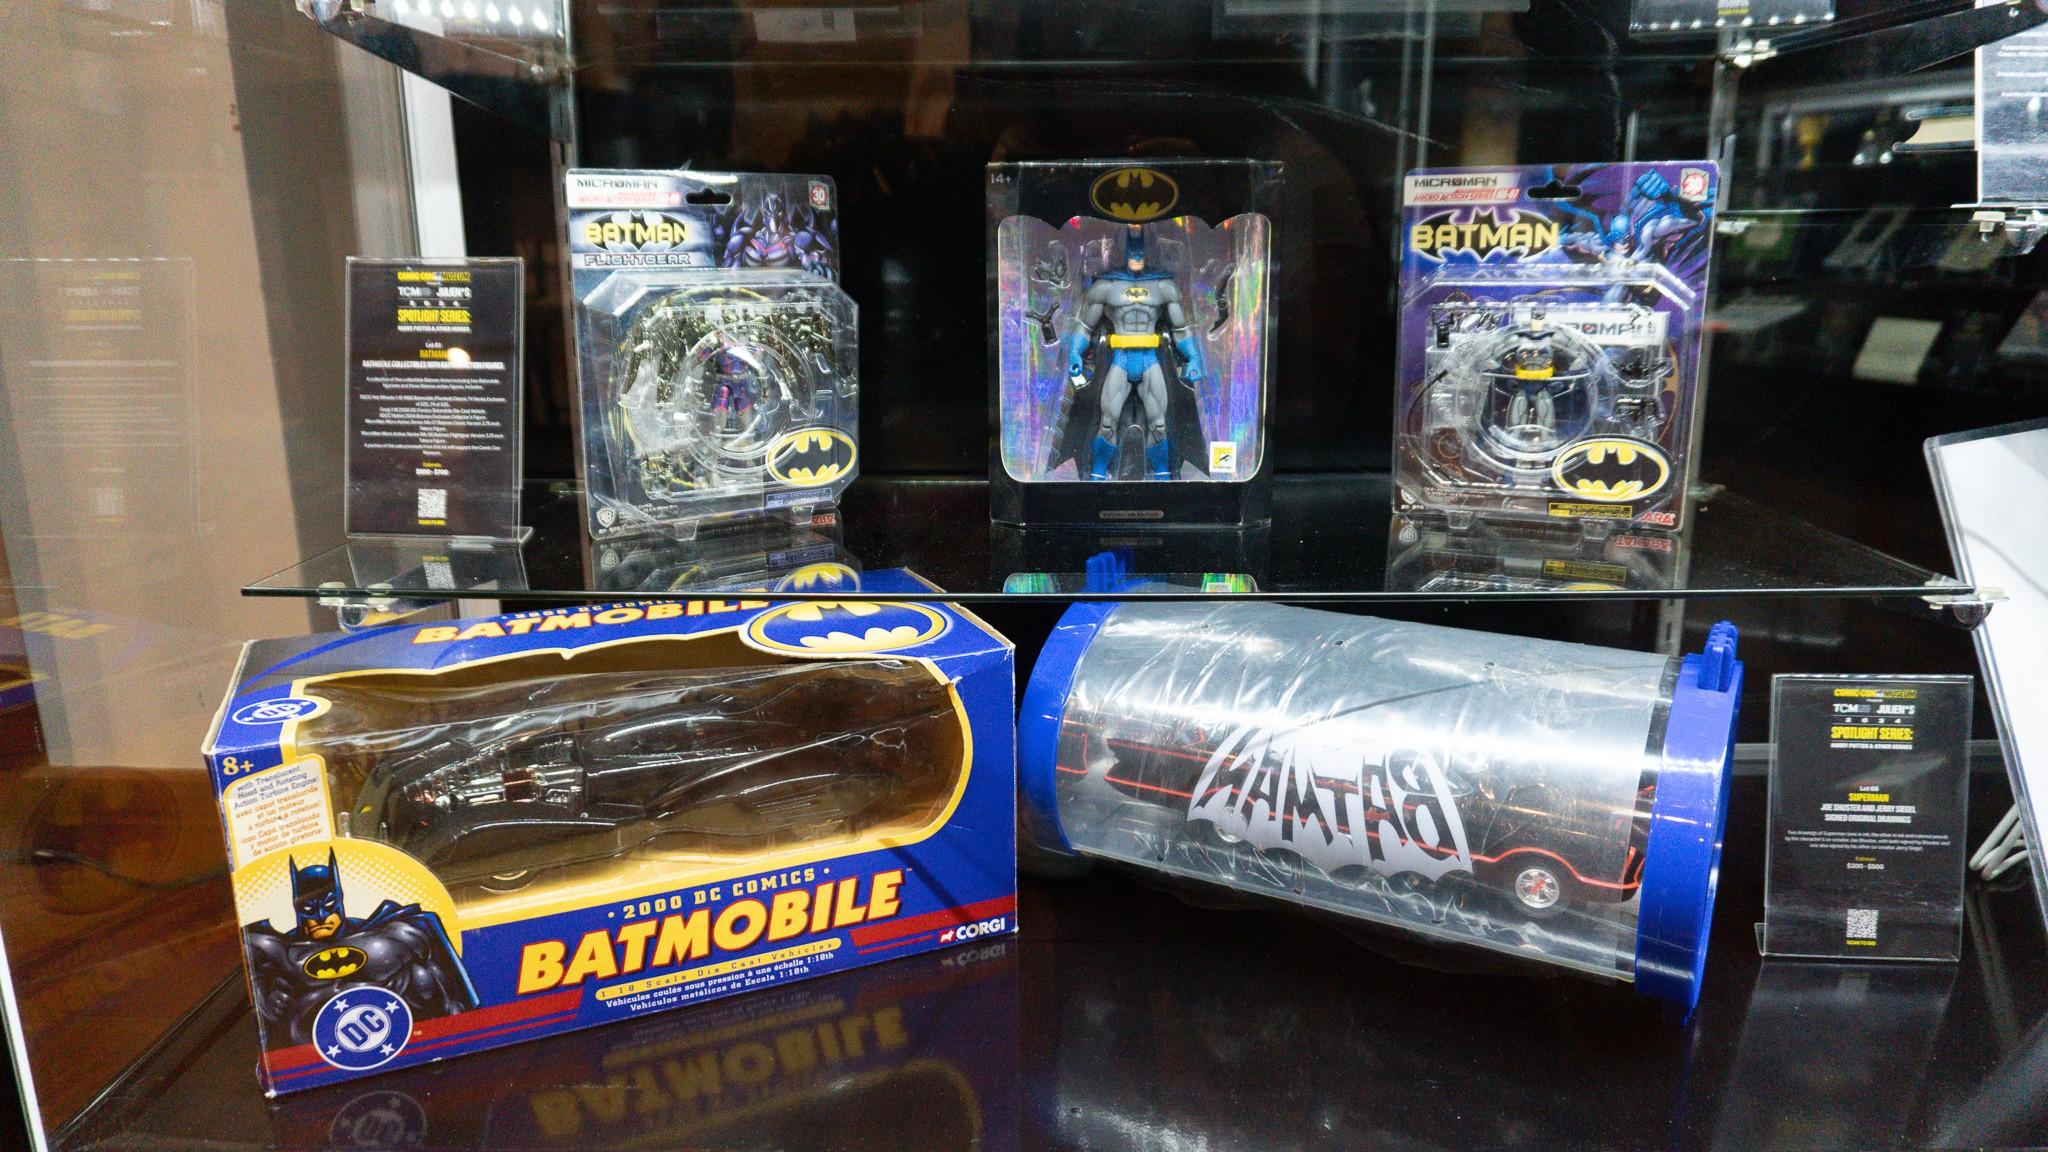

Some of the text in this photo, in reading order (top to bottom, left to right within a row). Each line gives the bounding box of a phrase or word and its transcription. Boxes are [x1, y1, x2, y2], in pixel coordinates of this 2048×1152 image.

[990, 173, 1011, 184] 14+
[585, 222, 689, 246] BATMAN
[1411, 223, 1559, 249] BATMAN
[584, 253, 690, 266] FLIGHTGEAR
[397, 309, 439, 323] SPOTLIGHT
[412, 593, 771, 645] BATMOBILE
[515, 608, 568, 619] 2000
[578, 604, 602, 614] DC
[1832, 703, 1915, 715] TCM JULIEN'S
[1831, 727, 1913, 741] SPOTLIGHT SERIES:
[222, 756, 254, 776] 8+
[238, 781, 254, 792] with
[260, 783, 273, 792] and
[1848, 793, 1889, 802] SUPERMAN
[623, 868, 815, 920] 2000 DC COMICS
[516, 869, 904, 995] BATMOBILE
[955, 917, 1006, 941] CORGI
[771, 943, 833, 960] Vehicles
[606, 993, 650, 1008] Véhicules
[653, 986, 682, 998] coulés
[684, 981, 706, 991] sous
[708, 972, 745, 988] pression
[756, 967, 772, 976] une
[774, 959, 804, 972] échelle
[807, 951, 834, 965] 1:18th
[730, 981, 741, 990] de
[745, 974, 775, 987] Escala
[780, 965, 809, 978] 1:18th
[339, 1008, 386, 1048] DC
